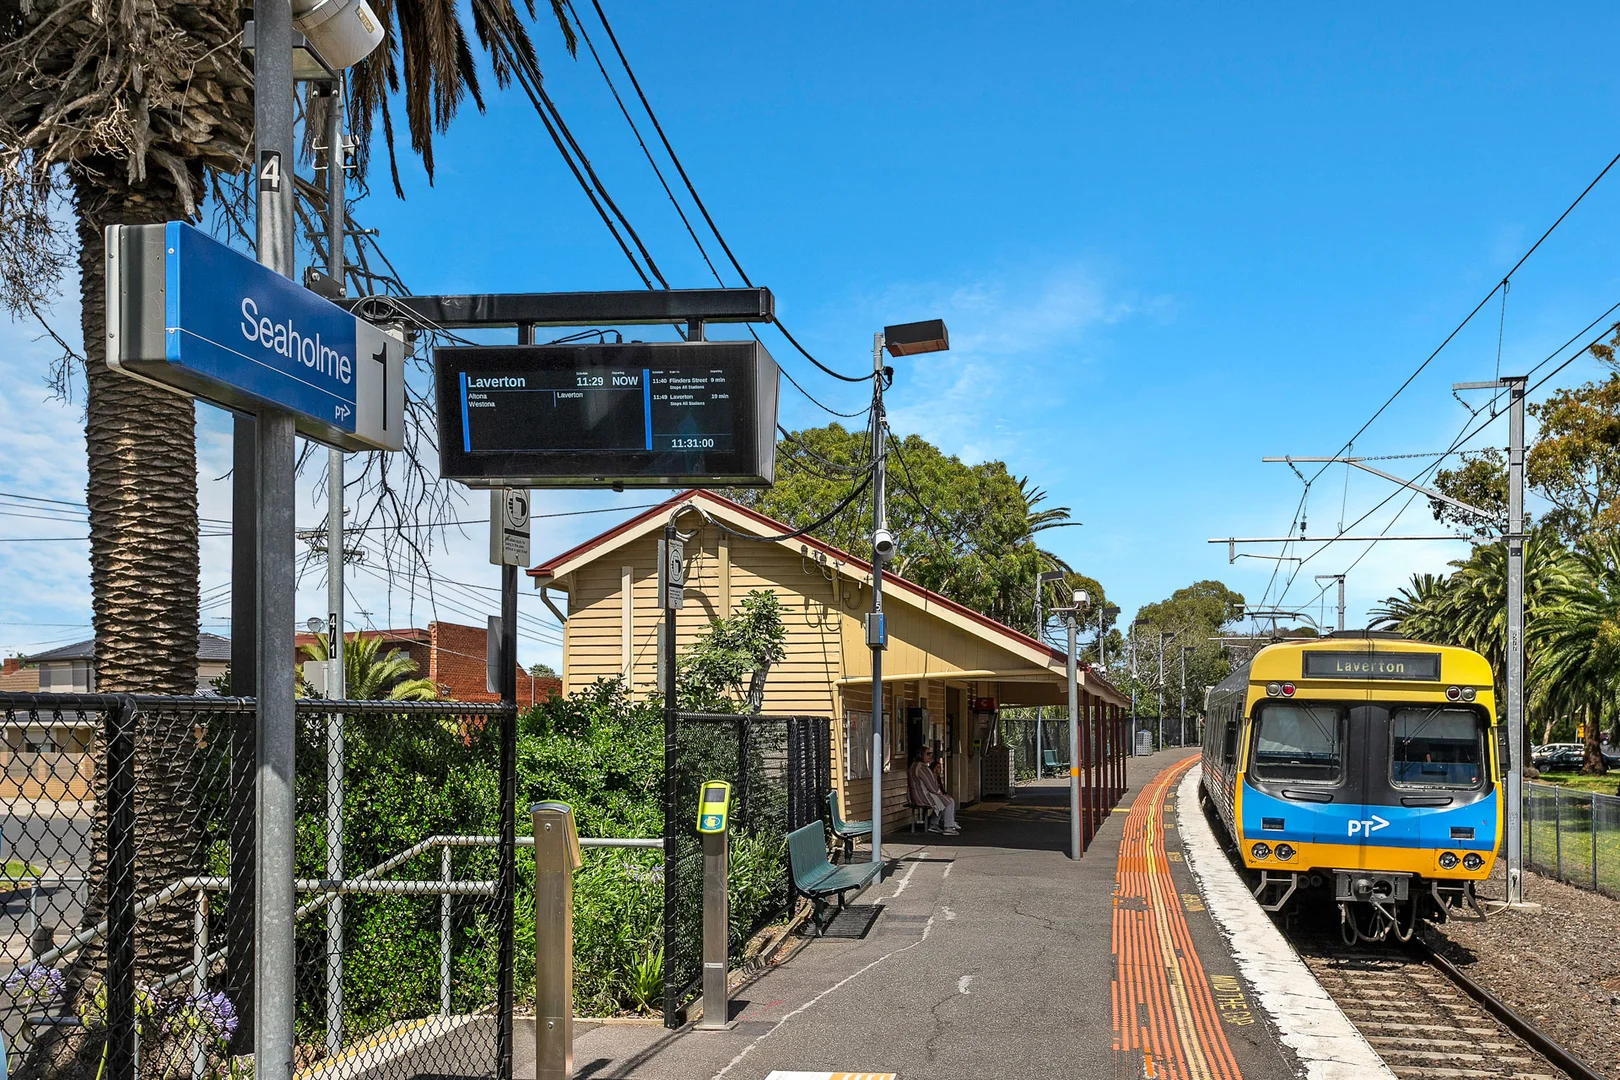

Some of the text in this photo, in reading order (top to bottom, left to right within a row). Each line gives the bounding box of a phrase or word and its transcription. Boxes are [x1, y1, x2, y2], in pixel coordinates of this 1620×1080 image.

[261, 155, 280, 188] 4
[240, 297, 351, 385] Seaholme
[372, 341, 387, 432] 1
[467, 376, 526, 388] Laverton
[576, 376, 604, 387] 11:29
[612, 376, 639, 386] NOW
[468, 400, 496, 408] Westona
[671, 438, 714, 448] 11:31:00
[875, 602, 881, 611] 5
[1336, 659, 1405, 673] Laverton
[1209, 974, 1255, 1026] MIND THE GAP
